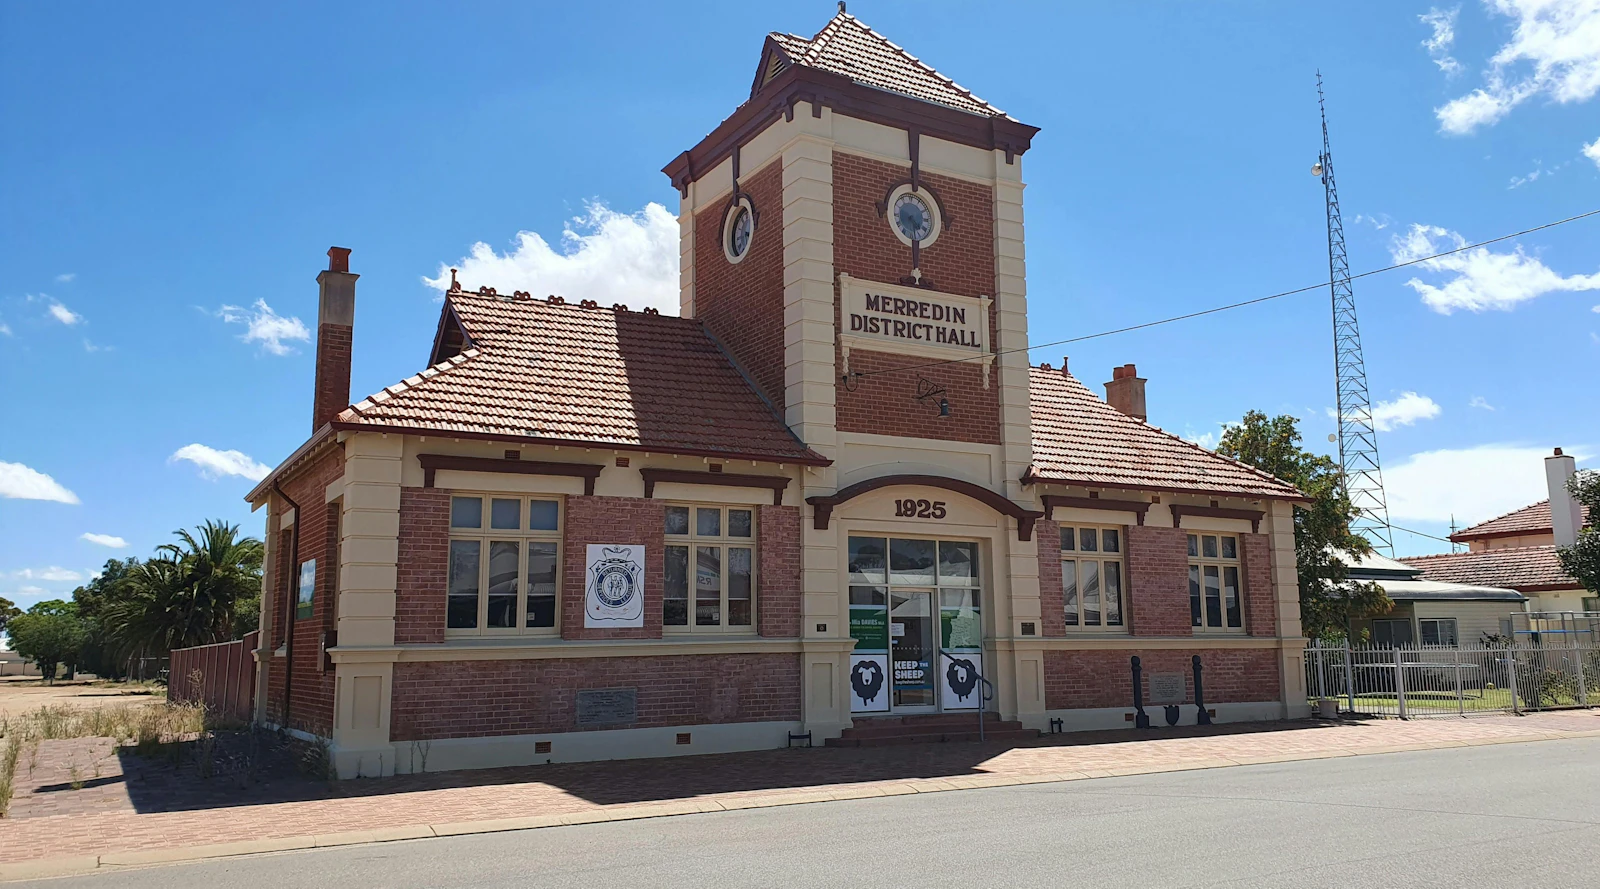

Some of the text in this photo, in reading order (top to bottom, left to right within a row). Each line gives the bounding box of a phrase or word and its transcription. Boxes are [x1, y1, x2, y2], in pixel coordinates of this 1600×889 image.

[865, 293, 966, 325] MERREDIN
[850, 313, 981, 348] DISTRICT HALL
[895, 498, 947, 519] 1925
[602, 567, 628, 576] RETURNED
[894, 661, 918, 670] KEEP
[894, 670, 924, 679] SHEEP
